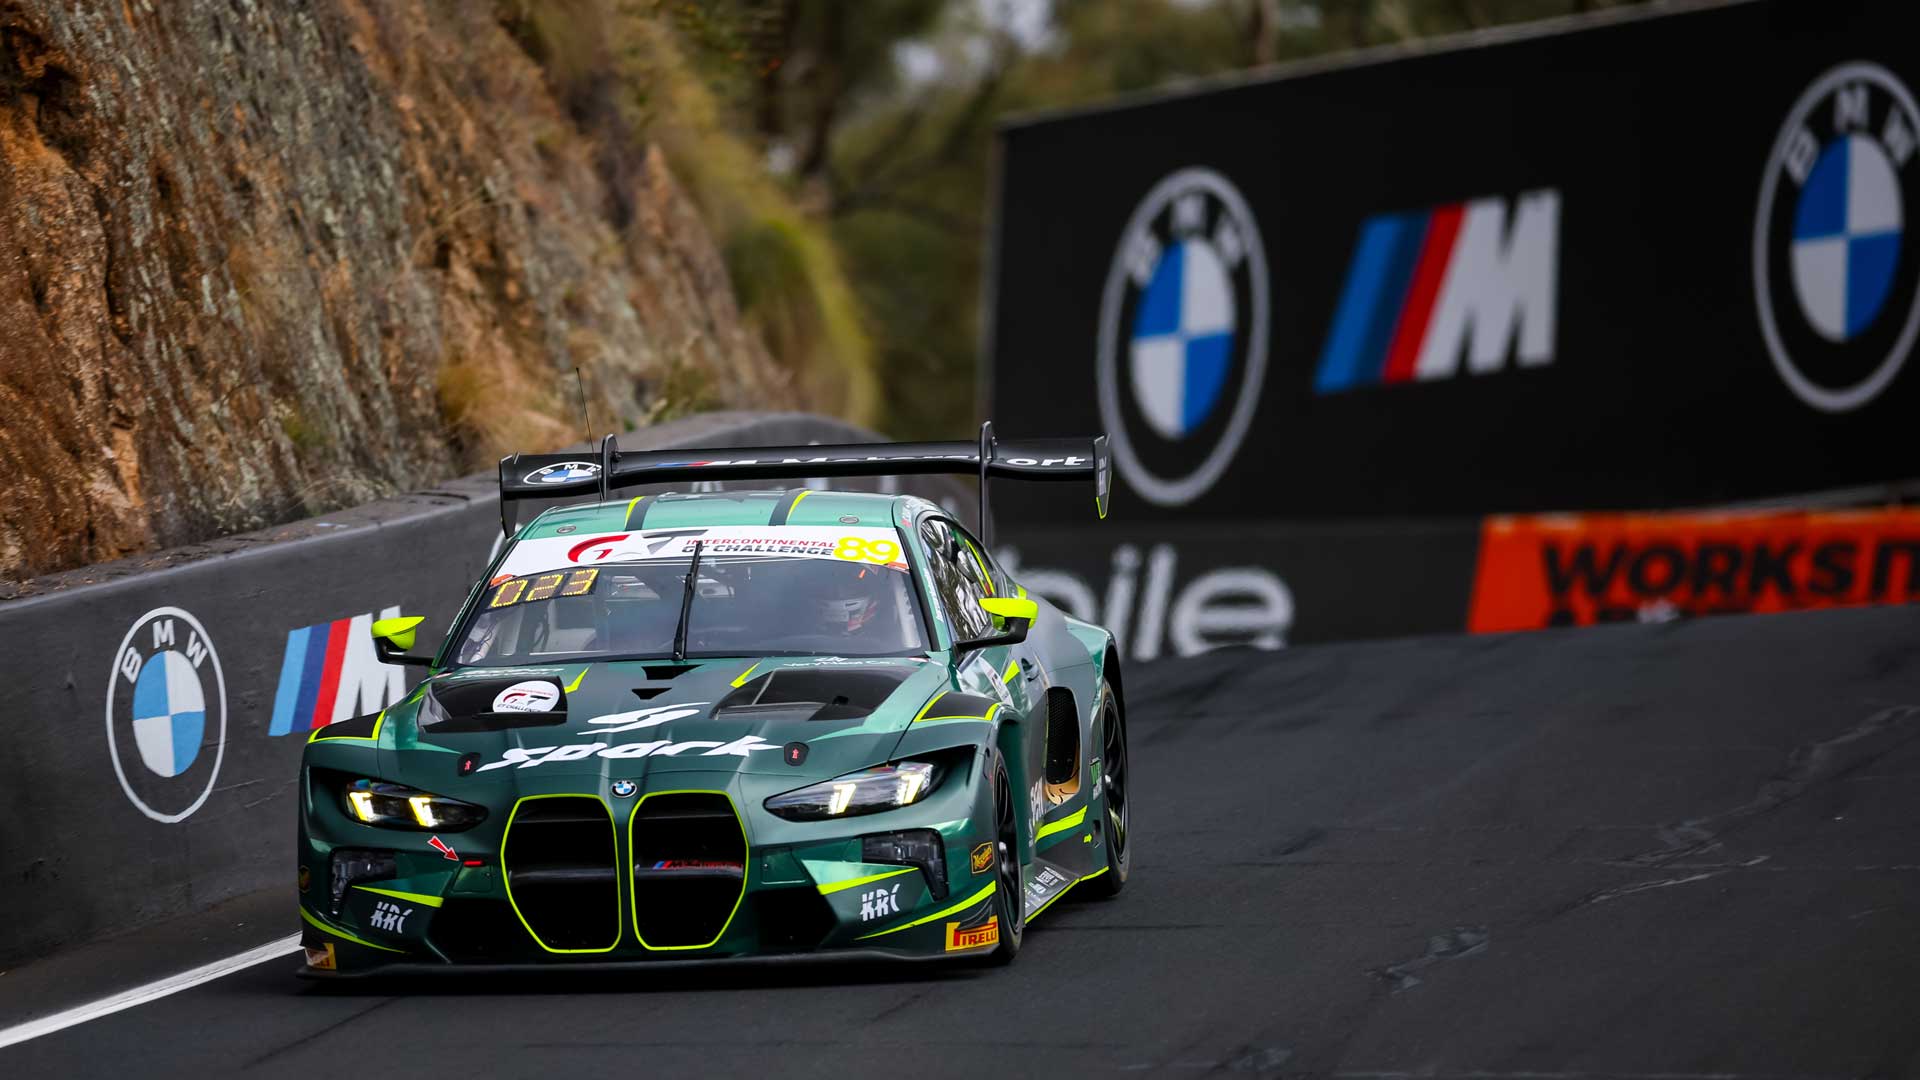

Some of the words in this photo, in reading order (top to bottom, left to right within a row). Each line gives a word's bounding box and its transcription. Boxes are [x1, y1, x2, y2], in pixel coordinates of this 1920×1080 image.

[1787, 84, 1917, 184] BMW
[682, 545, 710, 553] GT
[713, 544, 834, 556] CHALLENGE
[686, 538, 836, 548] INTERCONTINENTAL
[833, 536, 900, 565] 89
[491, 568, 598, 607] 023
[120, 619, 208, 684] BMW
[953, 922, 998, 947] PIRELLI
